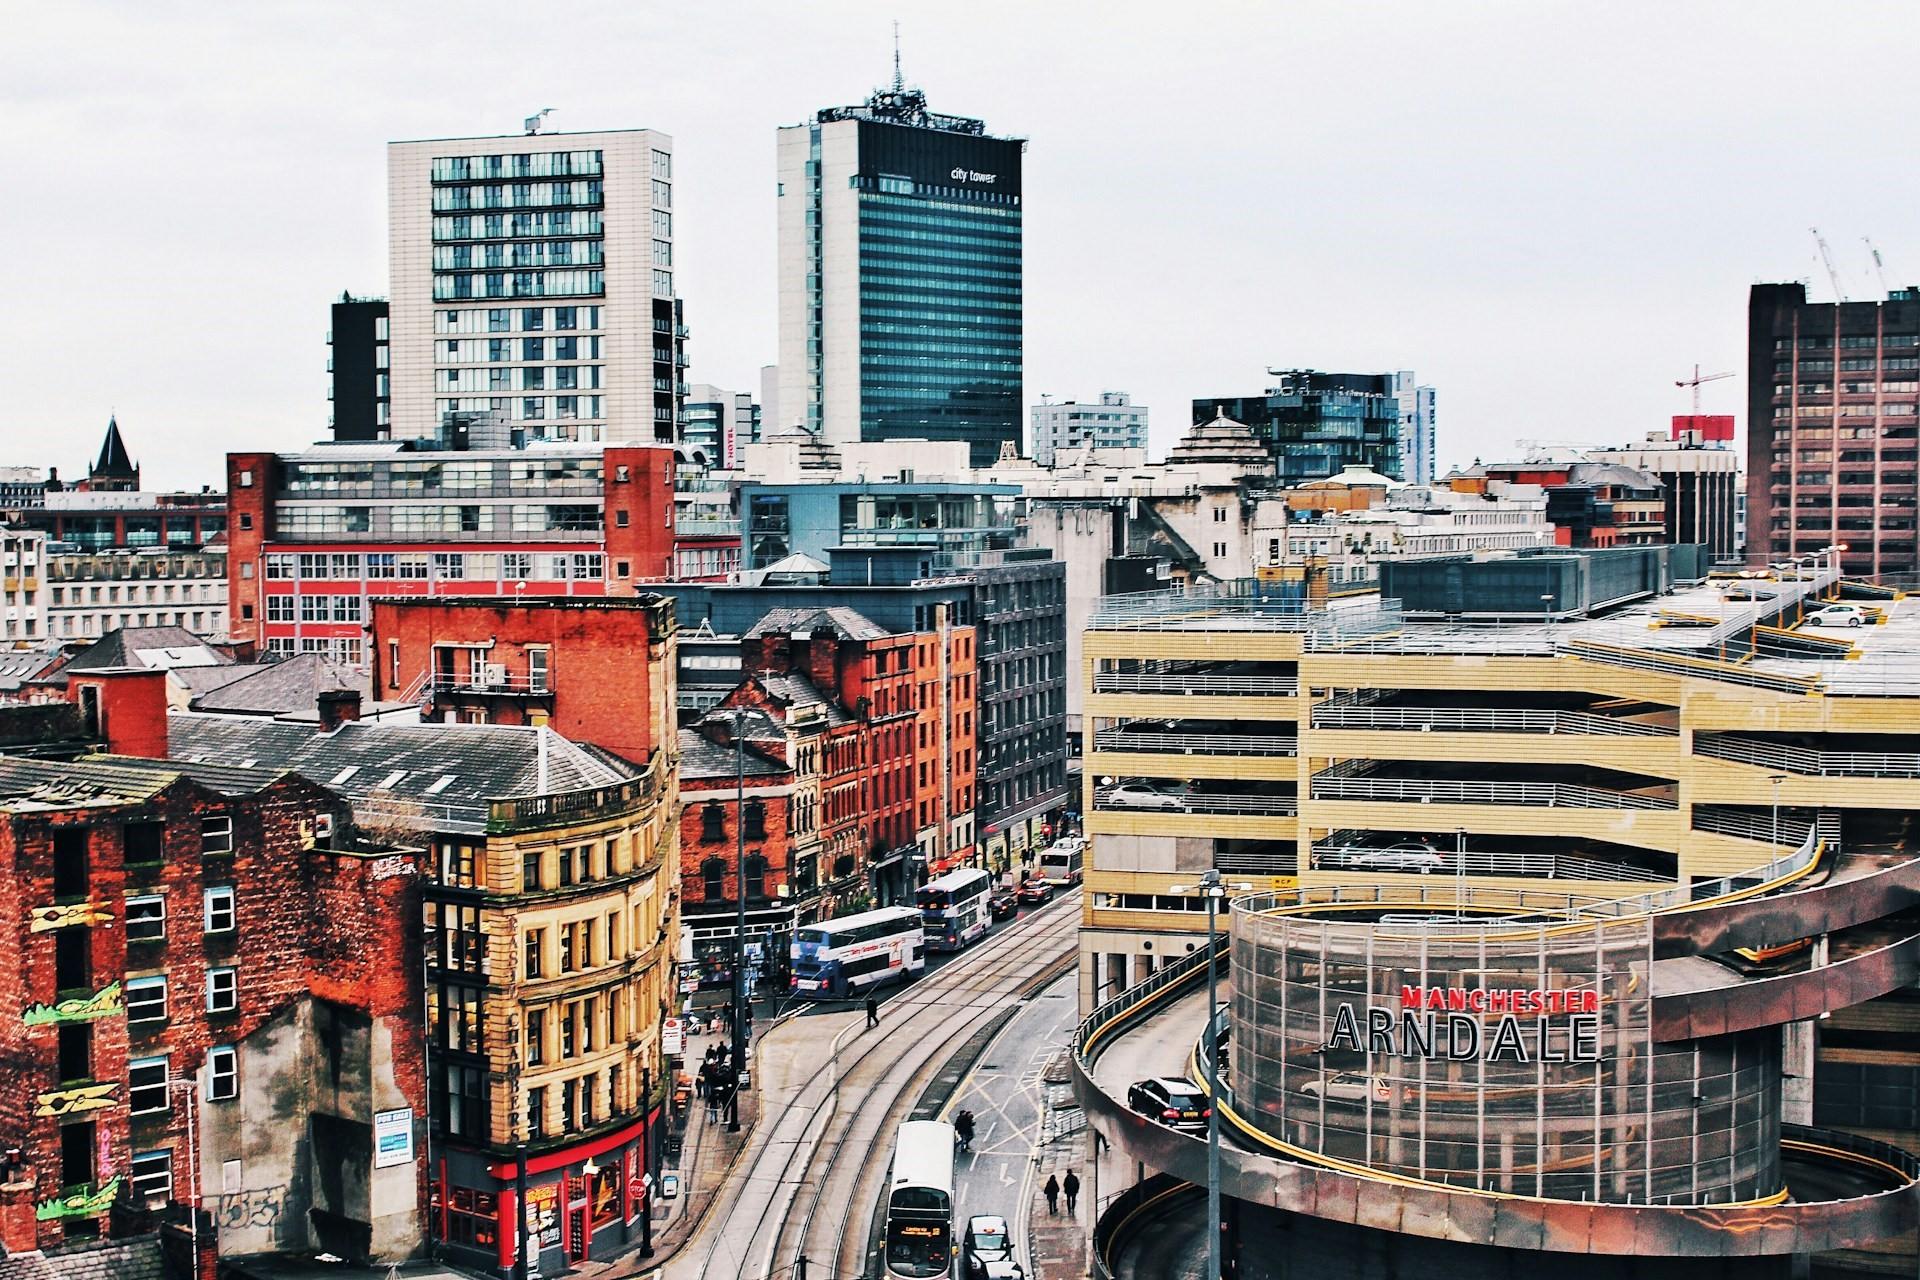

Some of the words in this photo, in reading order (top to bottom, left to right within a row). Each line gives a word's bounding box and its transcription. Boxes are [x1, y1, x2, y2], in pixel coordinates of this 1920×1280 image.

[950, 166, 968, 184] city
[969, 169, 998, 184] tower
[1402, 985, 1599, 1013] MANCHESTER
[1327, 1002, 1598, 1063] ARNDALE
[508, 1012, 521, 1142] CHAMBERS
